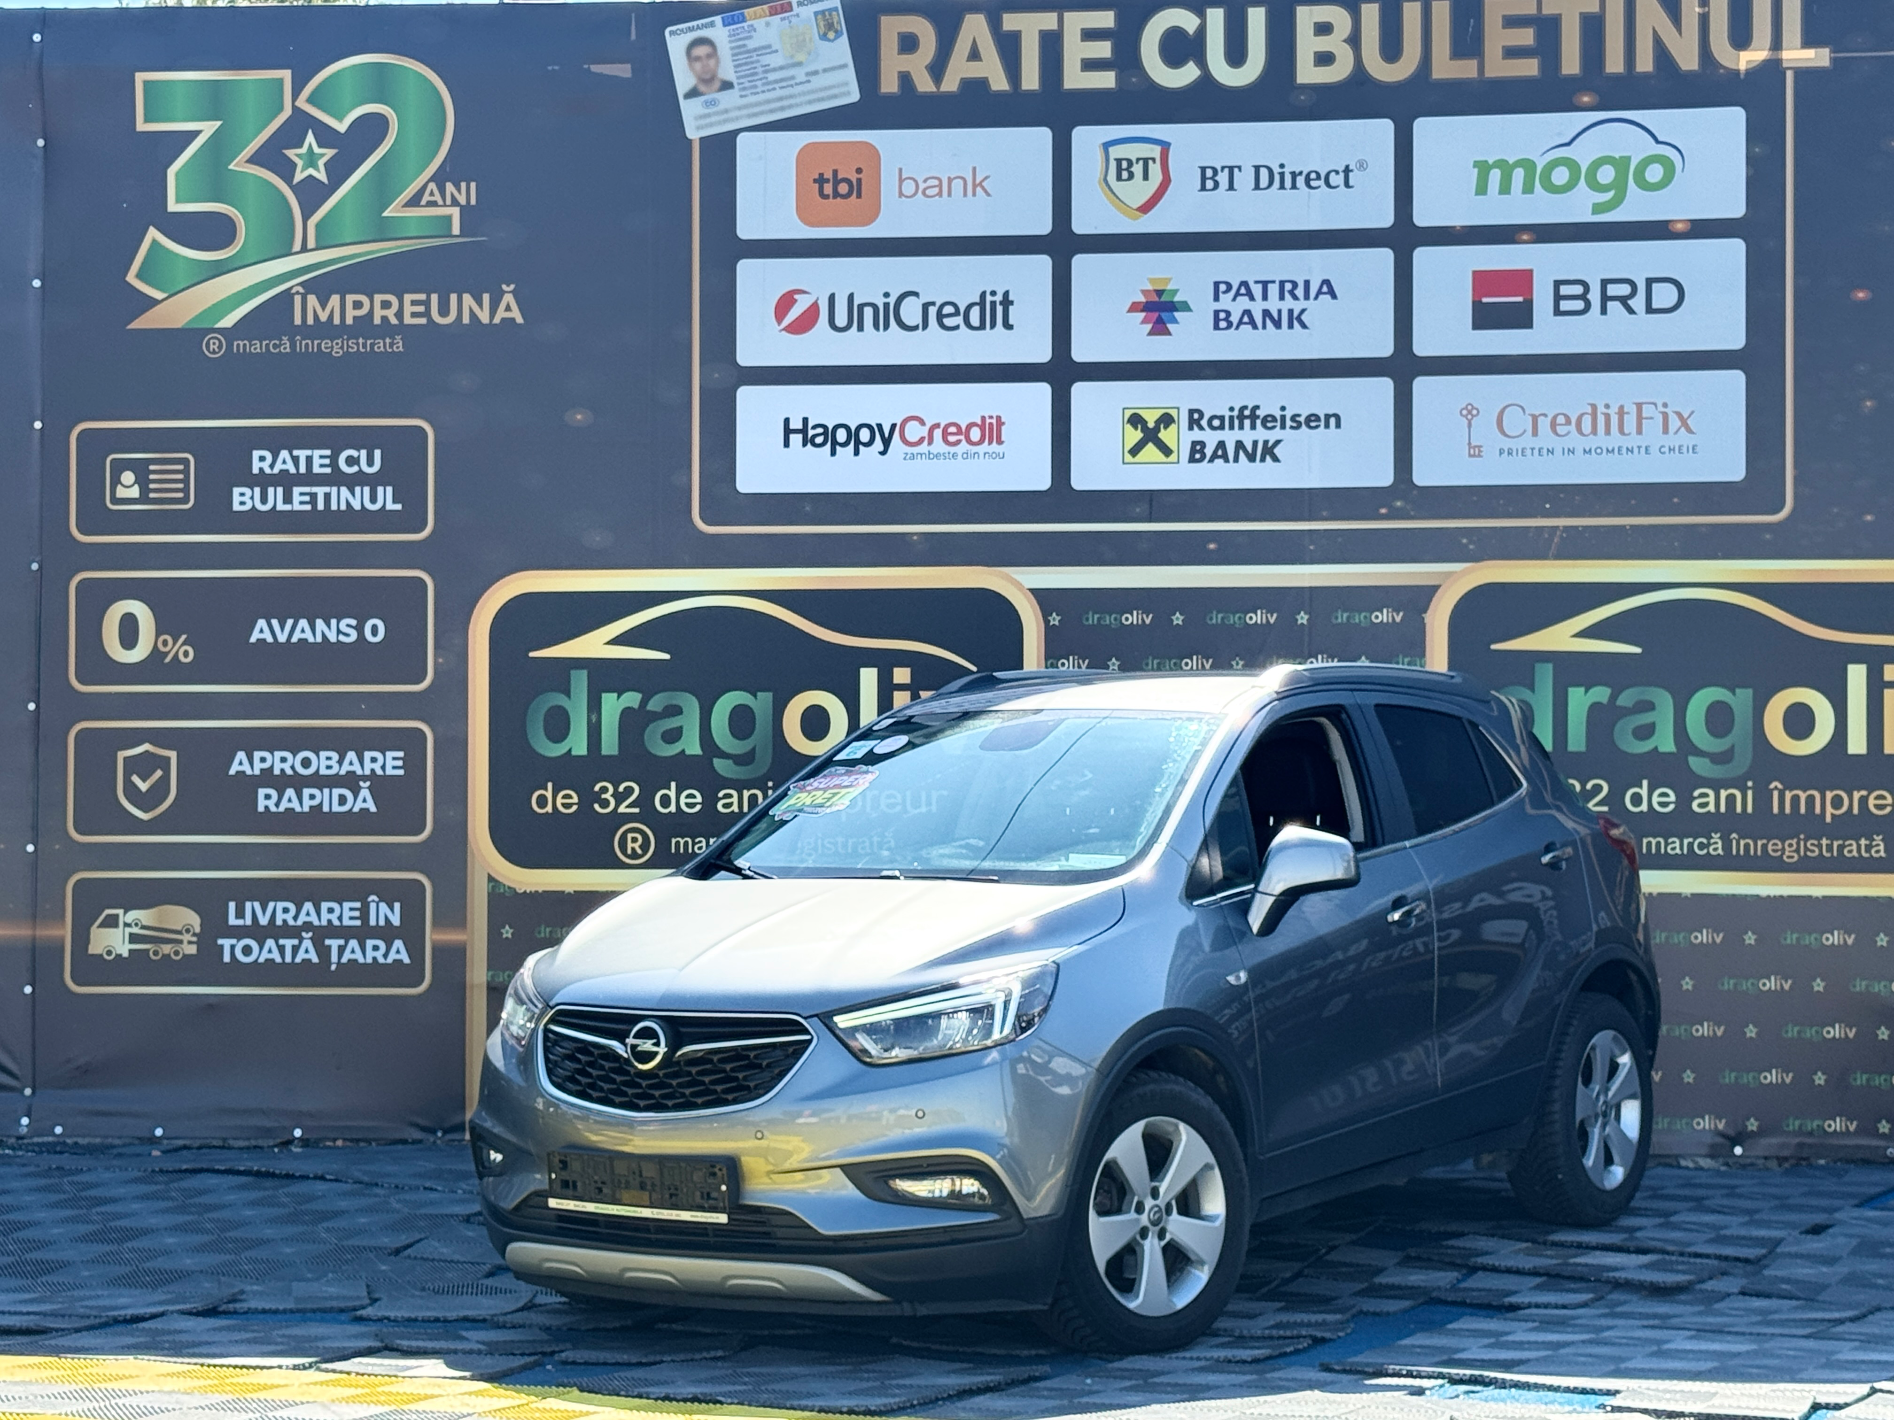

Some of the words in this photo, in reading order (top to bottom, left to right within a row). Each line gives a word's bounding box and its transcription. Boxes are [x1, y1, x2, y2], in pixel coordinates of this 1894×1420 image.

[668, 20, 717, 38] ROUMANIE
[879, 10, 1117, 94] RATE
[1139, 6, 1268, 89] CU
[1295, 0, 1831, 85] BULETINUL
[125, 53, 460, 301] 32
[420, 181, 477, 206] ANI
[1114, 156, 1156, 183] BT
[1197, 165, 1242, 192] BT
[813, 167, 863, 200] tbi
[897, 167, 992, 199] bank
[1472, 153, 1677, 215] mogo
[1212, 278, 1339, 303] PATRIA
[1552, 276, 1686, 317] BRD
[292, 284, 524, 326] ÎMPREUNĂ
[827, 289, 1015, 333] UniCredit
[1212, 307, 1311, 331] BANK
[232, 333, 291, 354] marcă
[296, 334, 404, 358] înregistrată
[1187, 405, 1342, 432] Raiffeisen
[1495, 401, 1697, 439] CreditFix
[783, 415, 1006, 457] HappyCredit
[251, 449, 332, 475] RATE
[338, 448, 382, 474] CU
[903, 450, 959, 462] zambeste
[961, 449, 980, 461] din
[984, 451, 1005, 461] nou
[1187, 439, 1284, 464] BANK
[1499, 446, 1555, 458] PRIETEN
[1562, 446, 1575, 457] IN
[1583, 445, 1652, 457] MOMENTE
[1658, 443, 1699, 456] CHEIE
[232, 486, 402, 512] BULETINUL
[1082, 609, 1153, 627] dragoliv
[1206, 608, 1277, 627] dragoliv
[1332, 607, 1404, 626] dragoliv
[249, 618, 358, 644] AVANS
[525, 667, 937, 779] dragol
[1499, 662, 1894, 779] dragoli
[228, 750, 405, 776] APROBARE
[256, 781, 377, 813] RAPIDĂ
[530, 781, 579, 814] de
[592, 781, 640, 814] 32
[653, 781, 703, 814] de
[1624, 778, 1676, 813] de
[1691, 781, 1753, 815] ani
[1768, 781, 1894, 823] împre
[1642, 832, 1724, 857] marcă
[1730, 833, 1887, 863] înregistrată
[227, 901, 362, 927] LIVRARE
[367, 894, 401, 927] ÎN
[217, 931, 319, 964] TOATĂ
[324, 937, 411, 971] ȚARA
[1781, 930, 1856, 948] dragoliv
[1717, 975, 1792, 993] dragoliv
[1661, 1021, 1725, 1040] ragoliv
[1782, 1023, 1857, 1041] dragoliv
[1719, 1068, 1794, 1087] dragoliv
[1783, 1116, 1857, 1135] dragoliv
